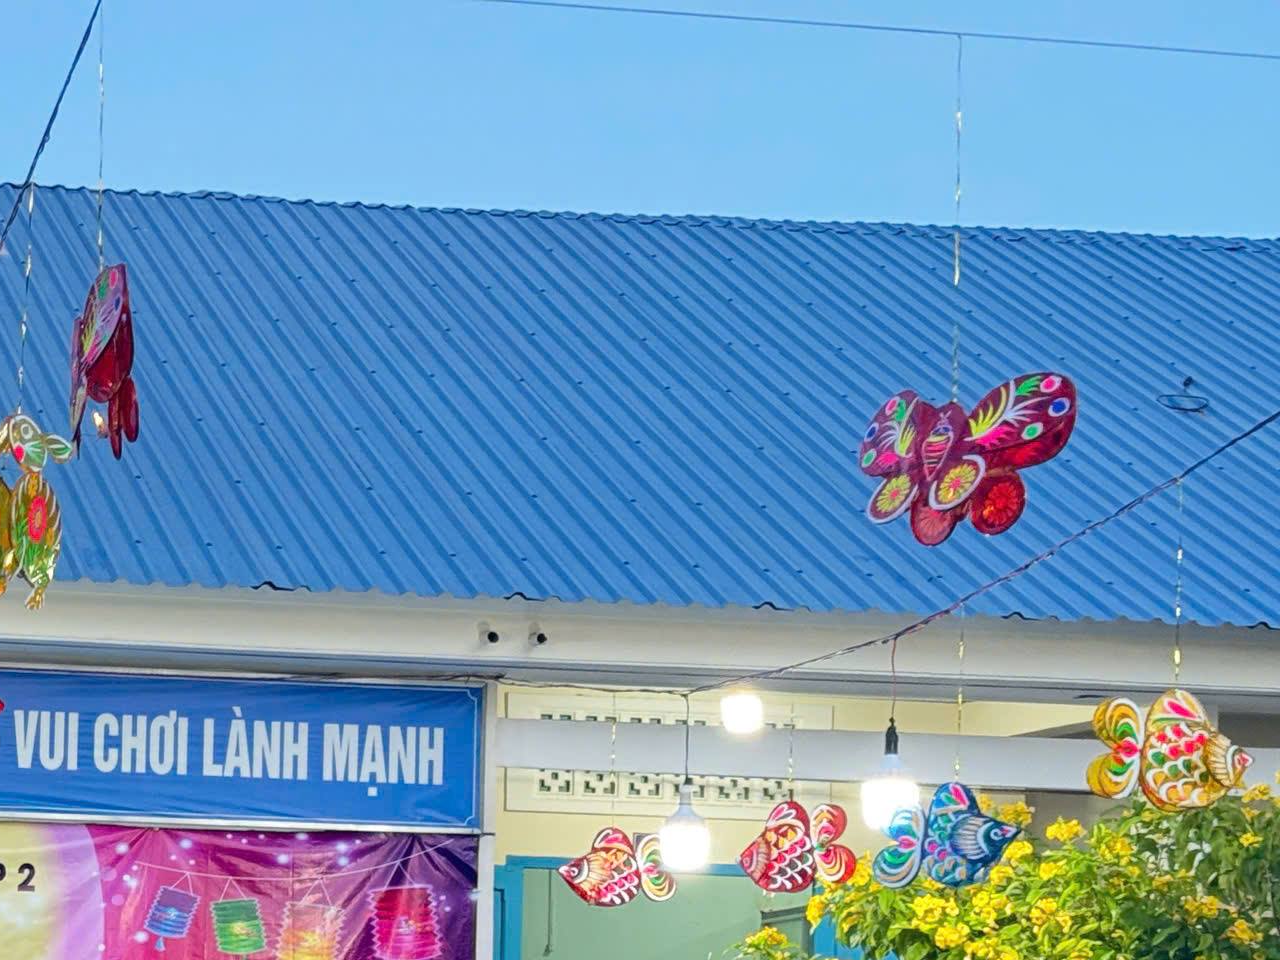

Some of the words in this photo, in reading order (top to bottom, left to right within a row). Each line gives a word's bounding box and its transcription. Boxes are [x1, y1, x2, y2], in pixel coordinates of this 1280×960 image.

[14, 709, 79, 771] VUI
[93, 707, 188, 776] CHƠI
[202, 705, 309, 781] LÀNH
[323, 722, 445, 797] MẠNH
[17, 862, 36, 892] 2
